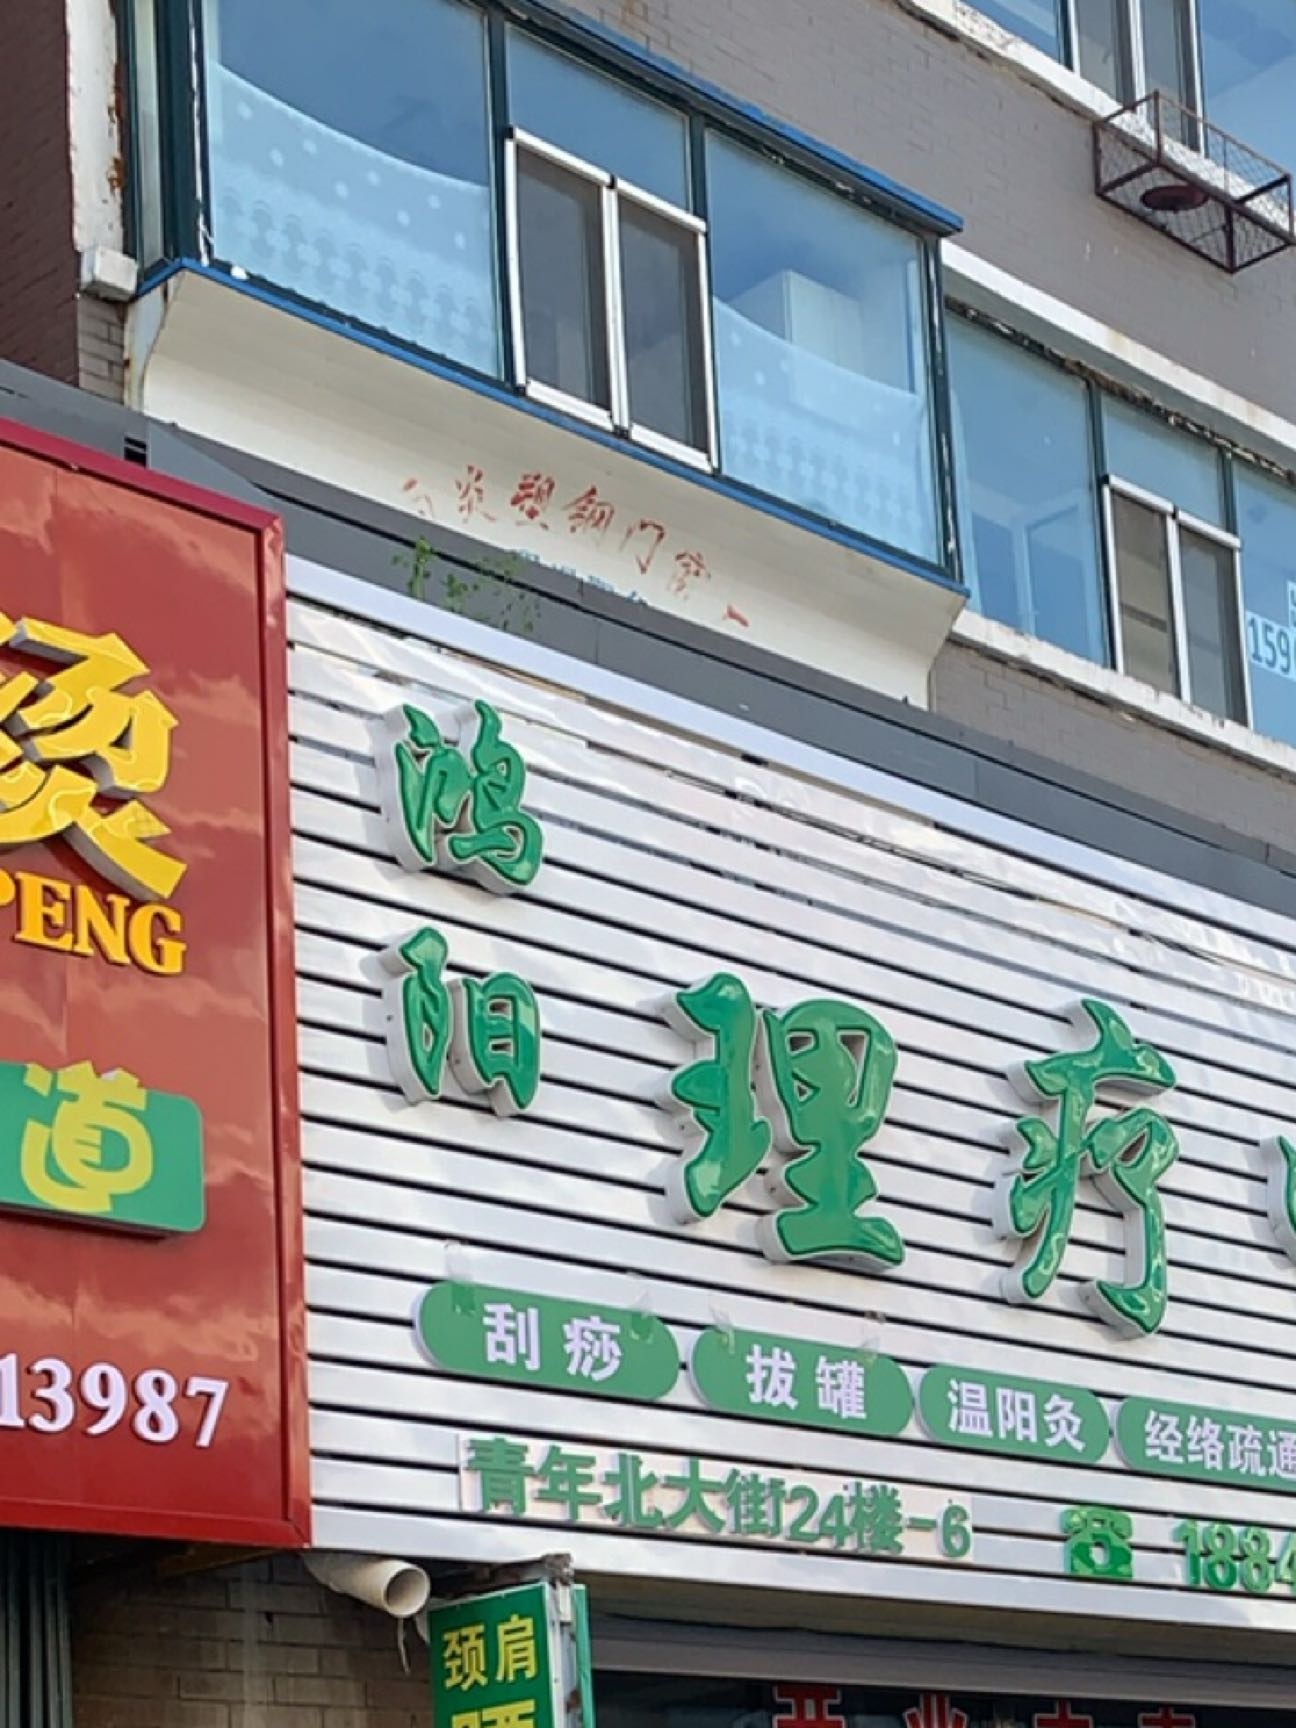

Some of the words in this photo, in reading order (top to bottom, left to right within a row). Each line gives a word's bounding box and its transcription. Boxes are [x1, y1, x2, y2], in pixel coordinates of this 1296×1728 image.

[20, 1060, 153, 1212] 道
[483, 1302, 622, 1381] 刮痧
[0, 1353, 229, 1448] 13987
[745, 1343, 868, 1421] 拔罐
[442, 1614, 540, 1692] 颈肩
